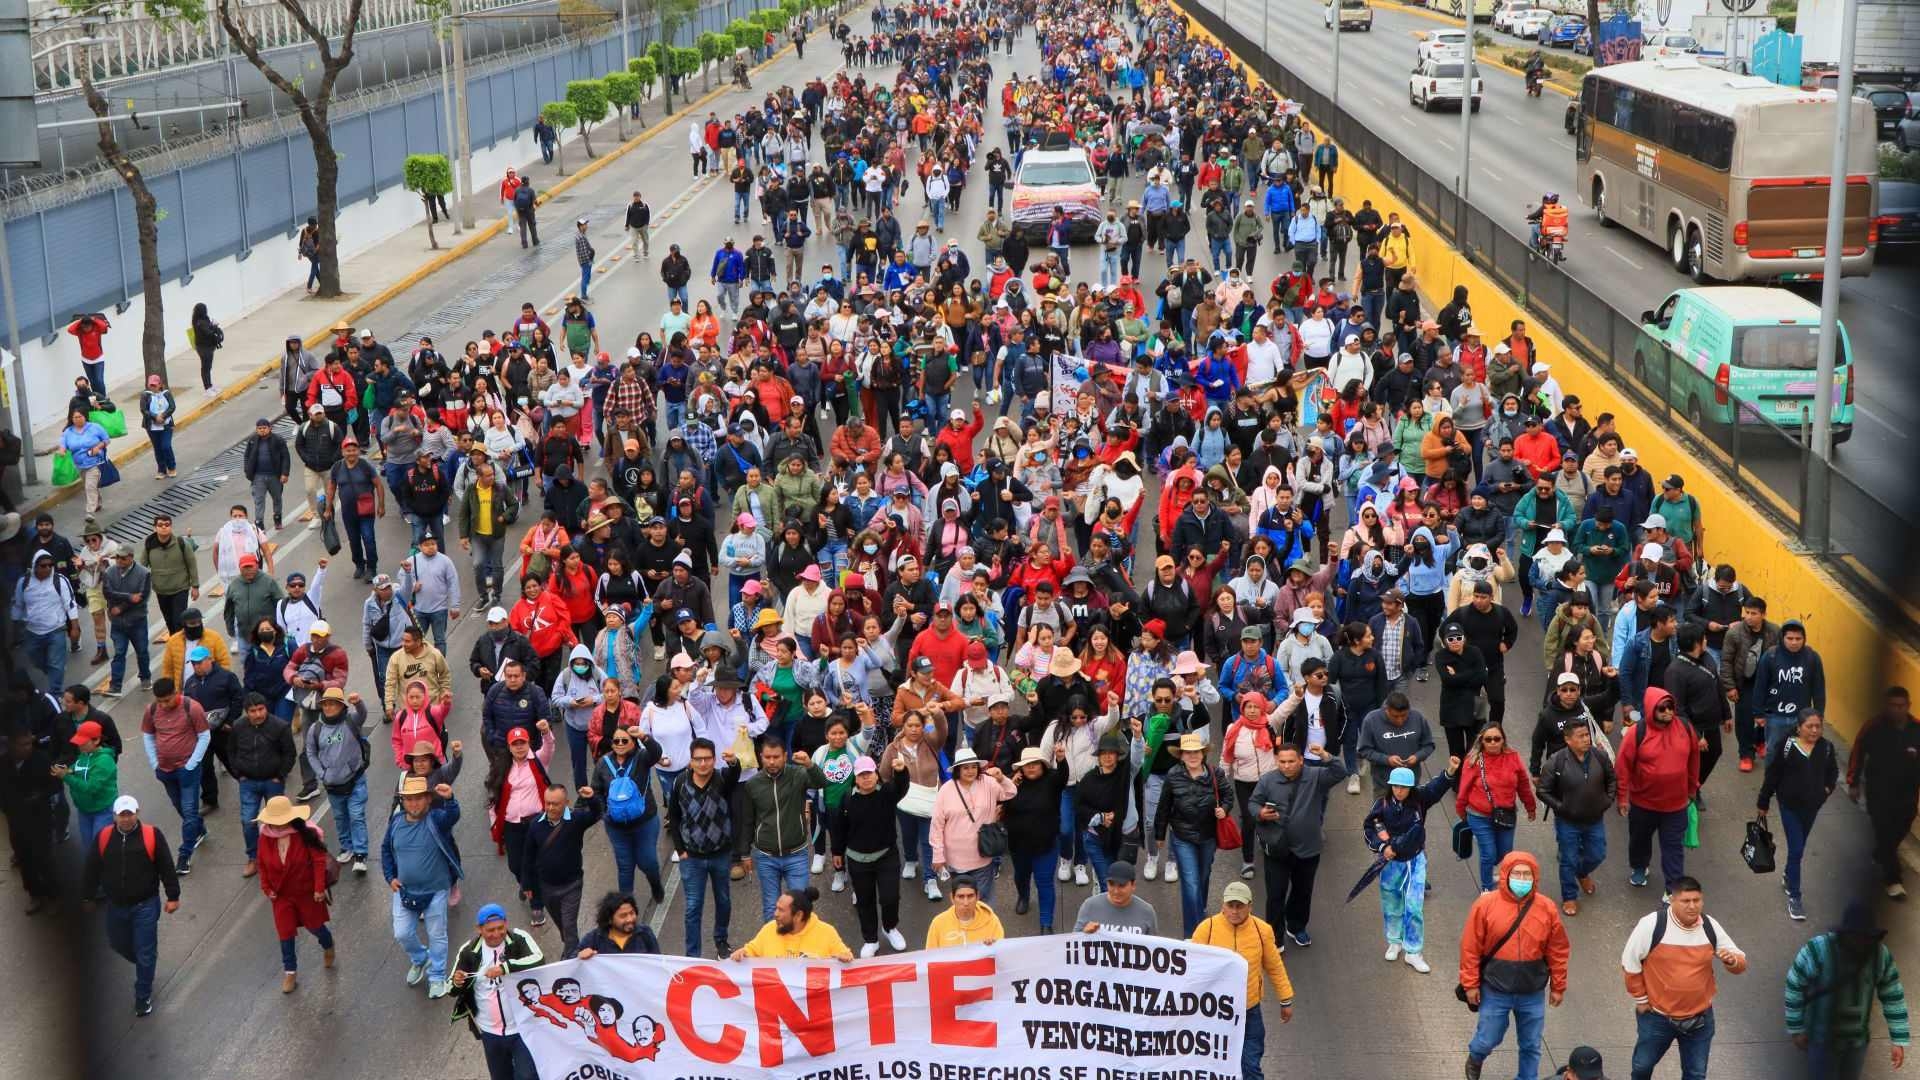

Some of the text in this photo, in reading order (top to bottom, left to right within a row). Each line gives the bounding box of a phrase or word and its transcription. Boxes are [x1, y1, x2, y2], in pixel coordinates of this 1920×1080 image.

[406, 663, 422, 672] NIKE
[1066, 941, 1187, 976] ¡¡UNIDOS
[667, 959, 996, 1066] CNTE
[1012, 978, 1240, 1025] Y ORGANIZADOS,
[1022, 1020, 1229, 1060] VENCEREMOS!!
[878, 1061, 921, 1079] LOS
[929, 1063, 1050, 1080] DERECHOS
